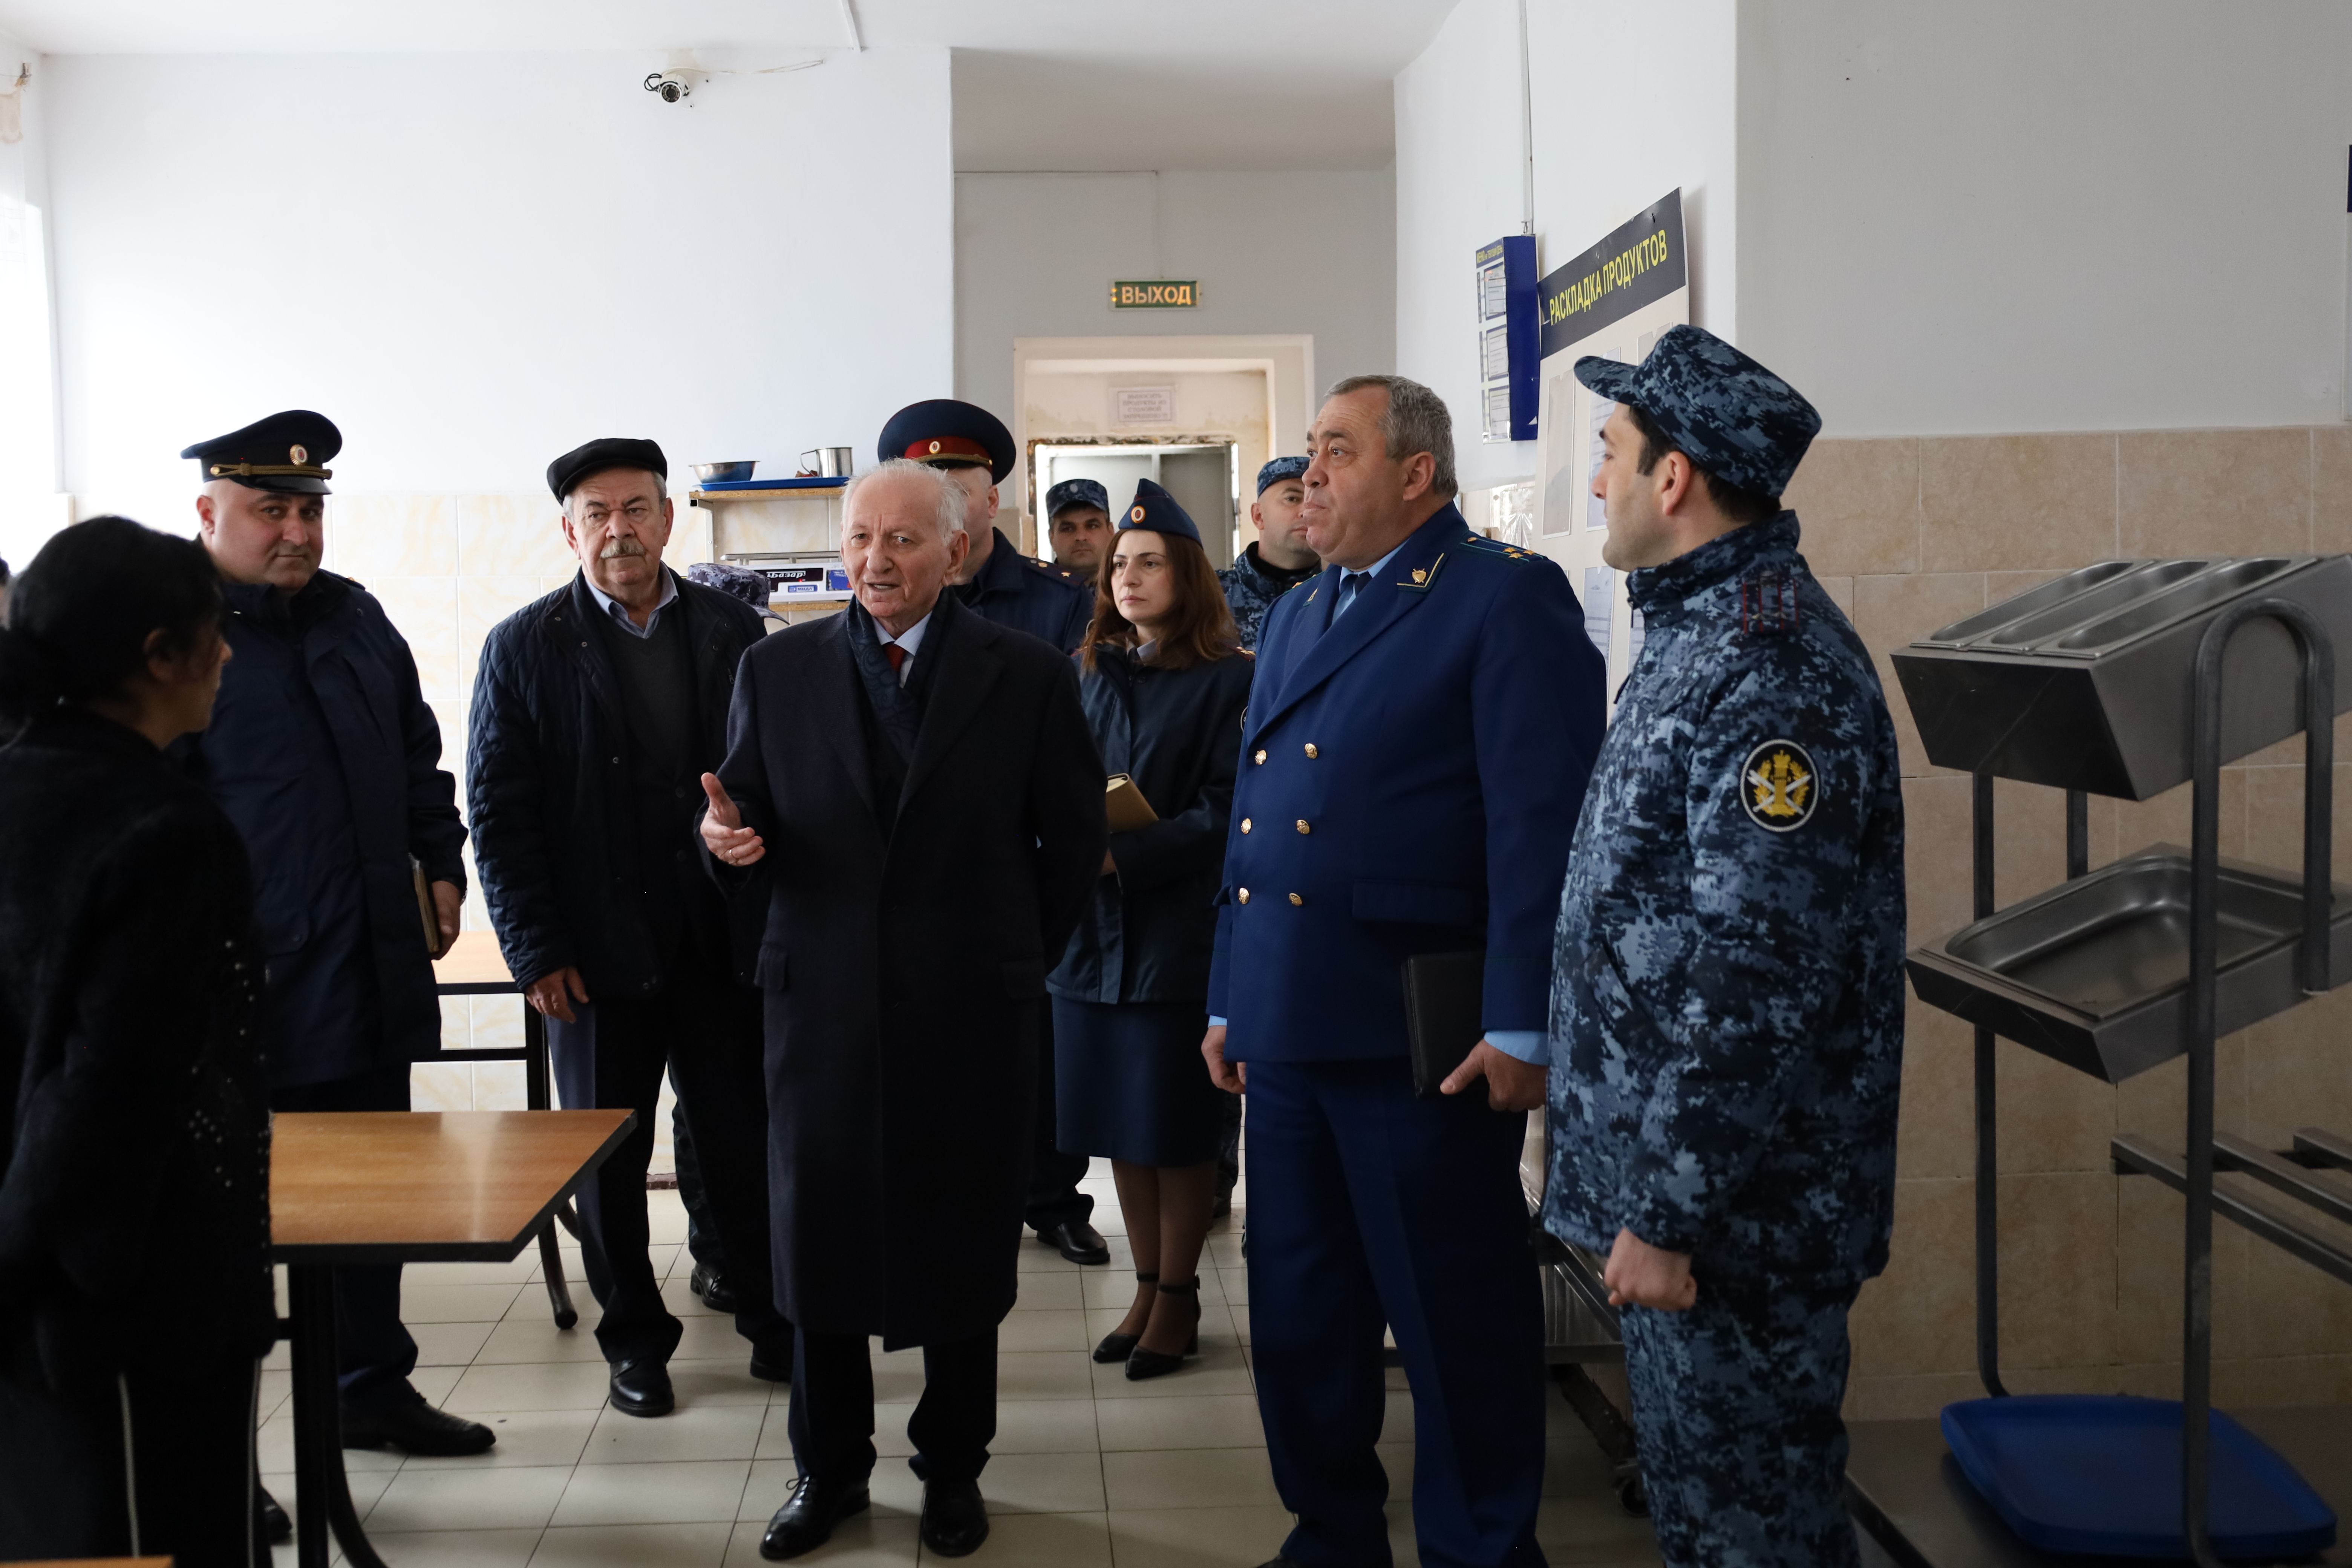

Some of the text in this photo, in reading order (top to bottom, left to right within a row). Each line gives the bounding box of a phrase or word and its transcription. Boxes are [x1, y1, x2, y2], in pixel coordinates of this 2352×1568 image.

[1121, 285, 1192, 305] ВЫХОД
[1549, 270, 1603, 326] РАСКЛАДКА
[1603, 229, 1668, 295] ПРОДУКТОВ
